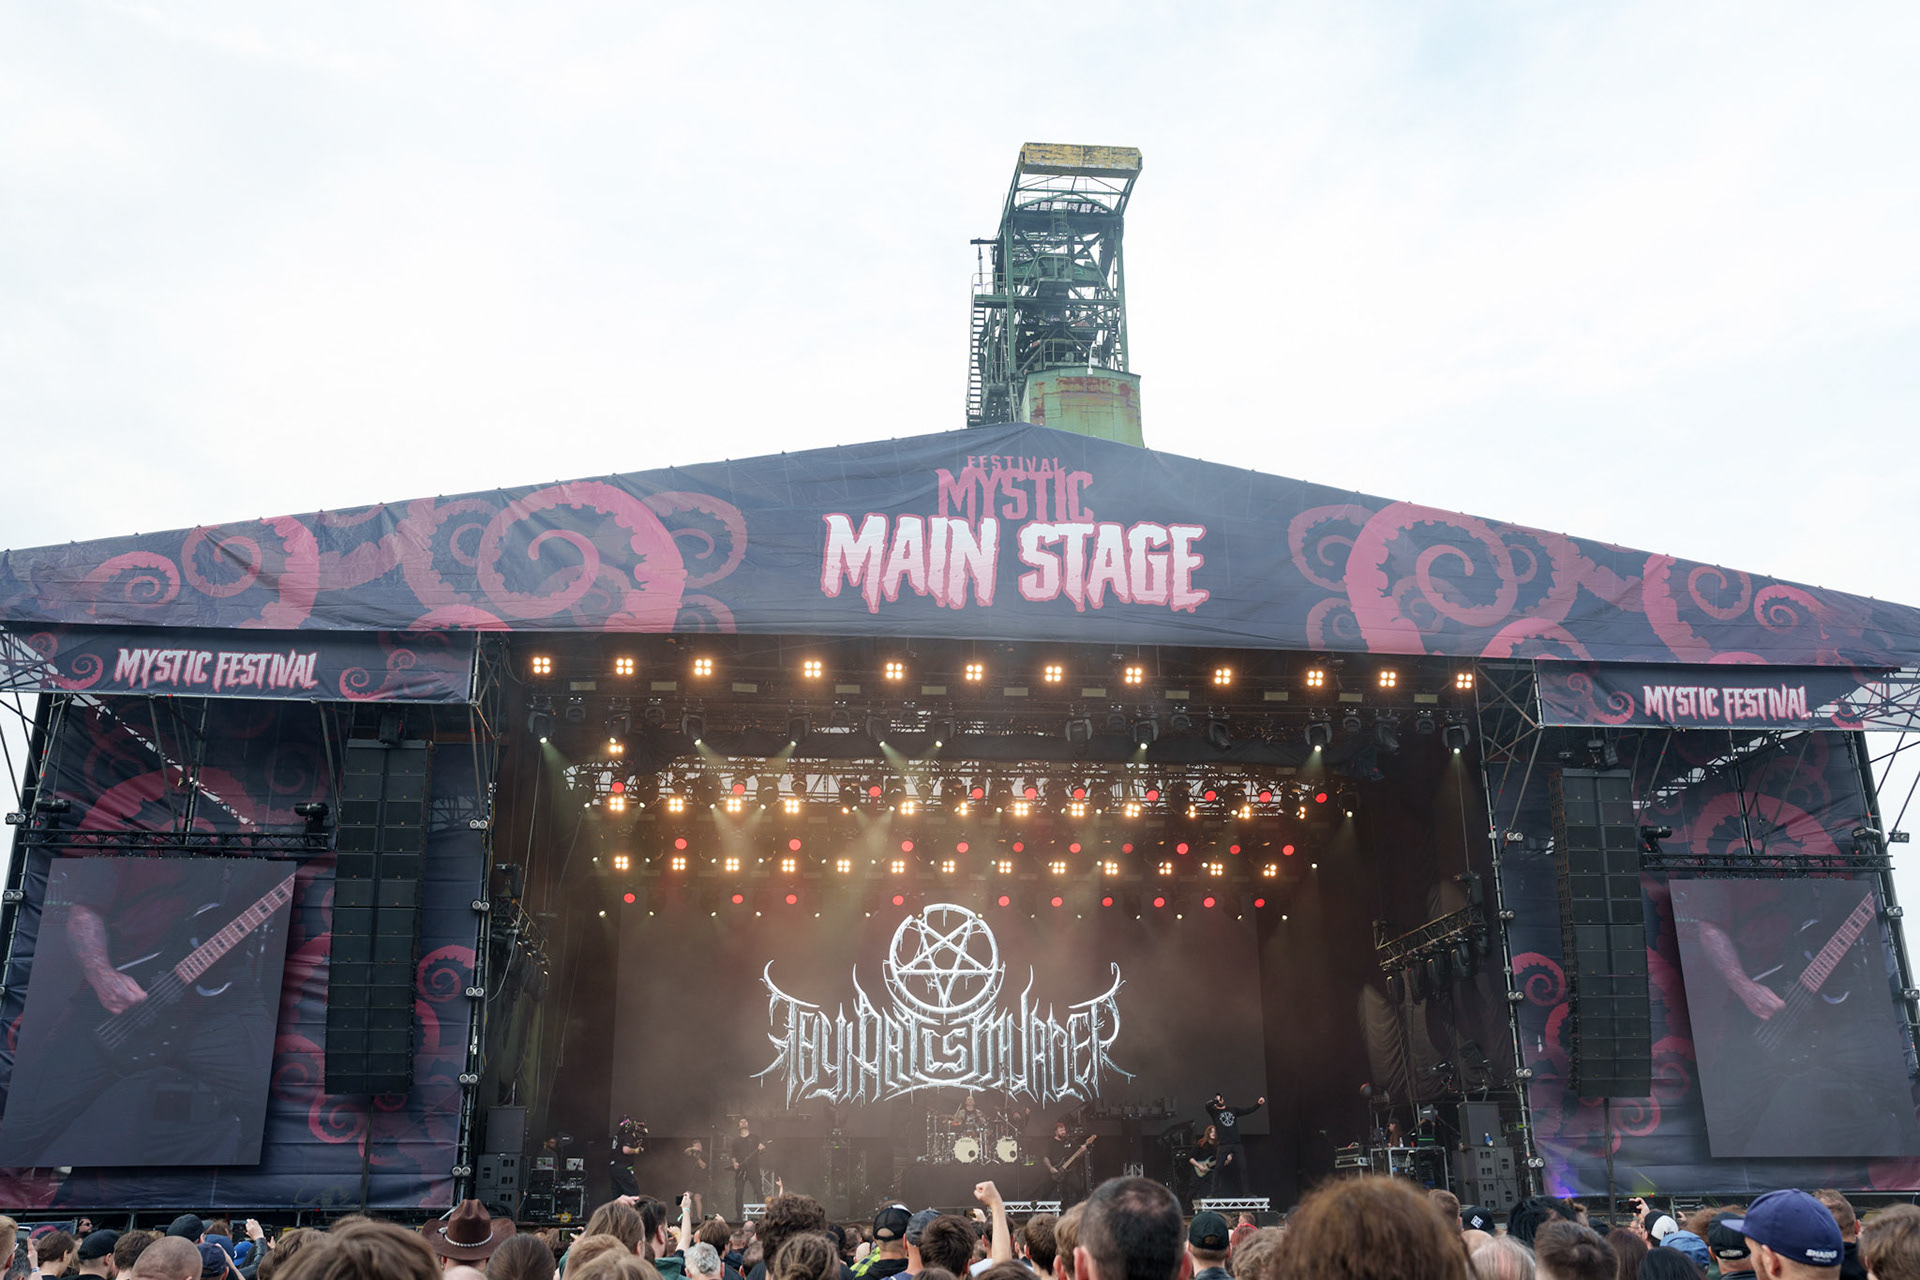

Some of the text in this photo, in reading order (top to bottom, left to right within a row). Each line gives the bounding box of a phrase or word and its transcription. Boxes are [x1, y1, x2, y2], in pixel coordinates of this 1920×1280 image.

[966, 455, 1066, 474] FESTIVAL
[935, 468, 1094, 524] MYSTIC
[820, 512, 1209, 614] MAIN STAGE
[114, 648, 319, 693] MYSTIC FESTIVAL
[1642, 682, 1813, 725] MYSTIC FESTIVAL
